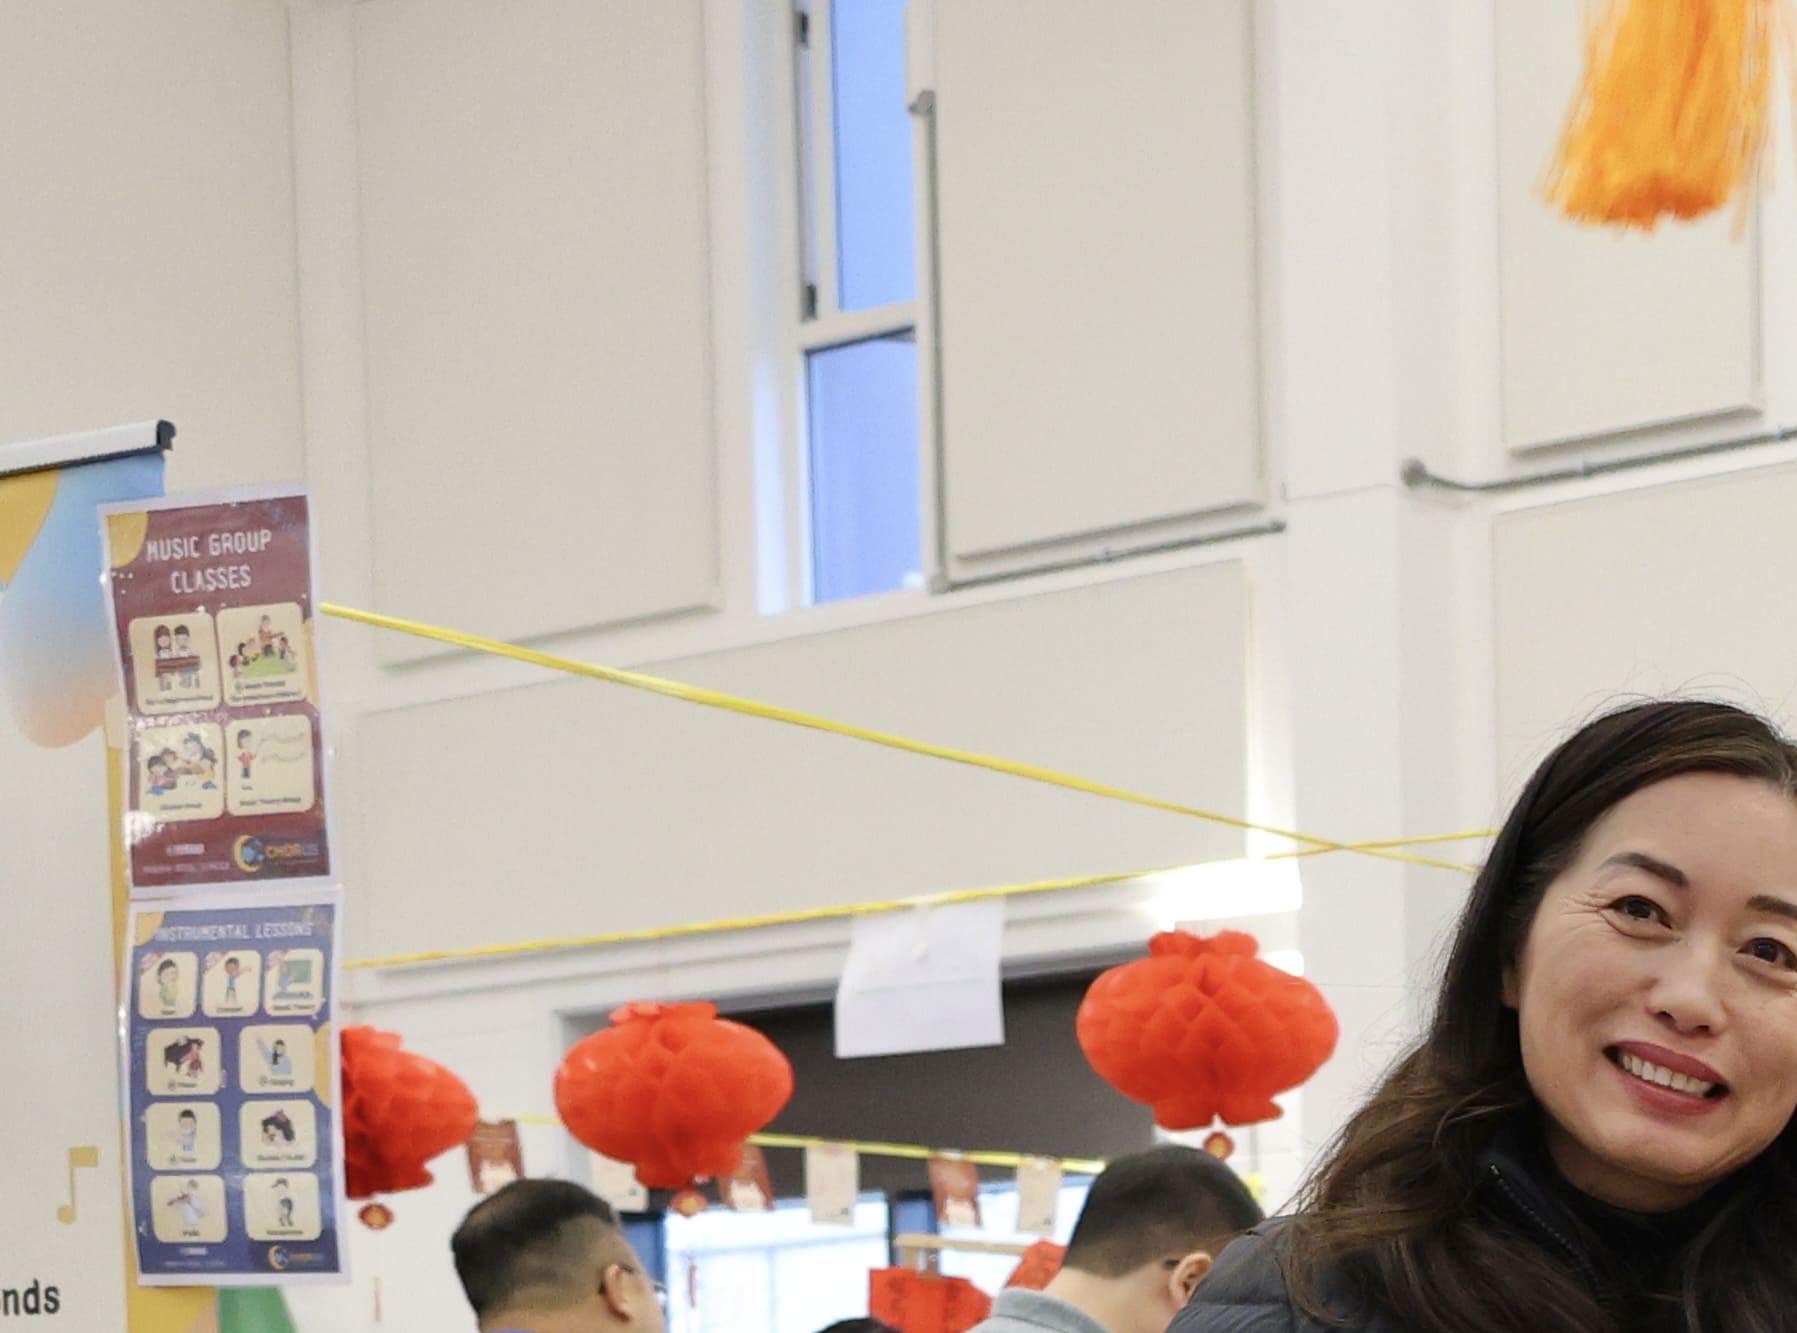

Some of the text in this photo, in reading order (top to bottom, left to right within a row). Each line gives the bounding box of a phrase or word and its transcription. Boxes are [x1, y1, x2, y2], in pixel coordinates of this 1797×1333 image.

[146, 529, 272, 562] MUSIC GROUP
[170, 565, 252, 594] CLASSES
[155, 921, 313, 942] INSTRUMENTAL LESSONS
[0, 1279, 61, 1317] nds
